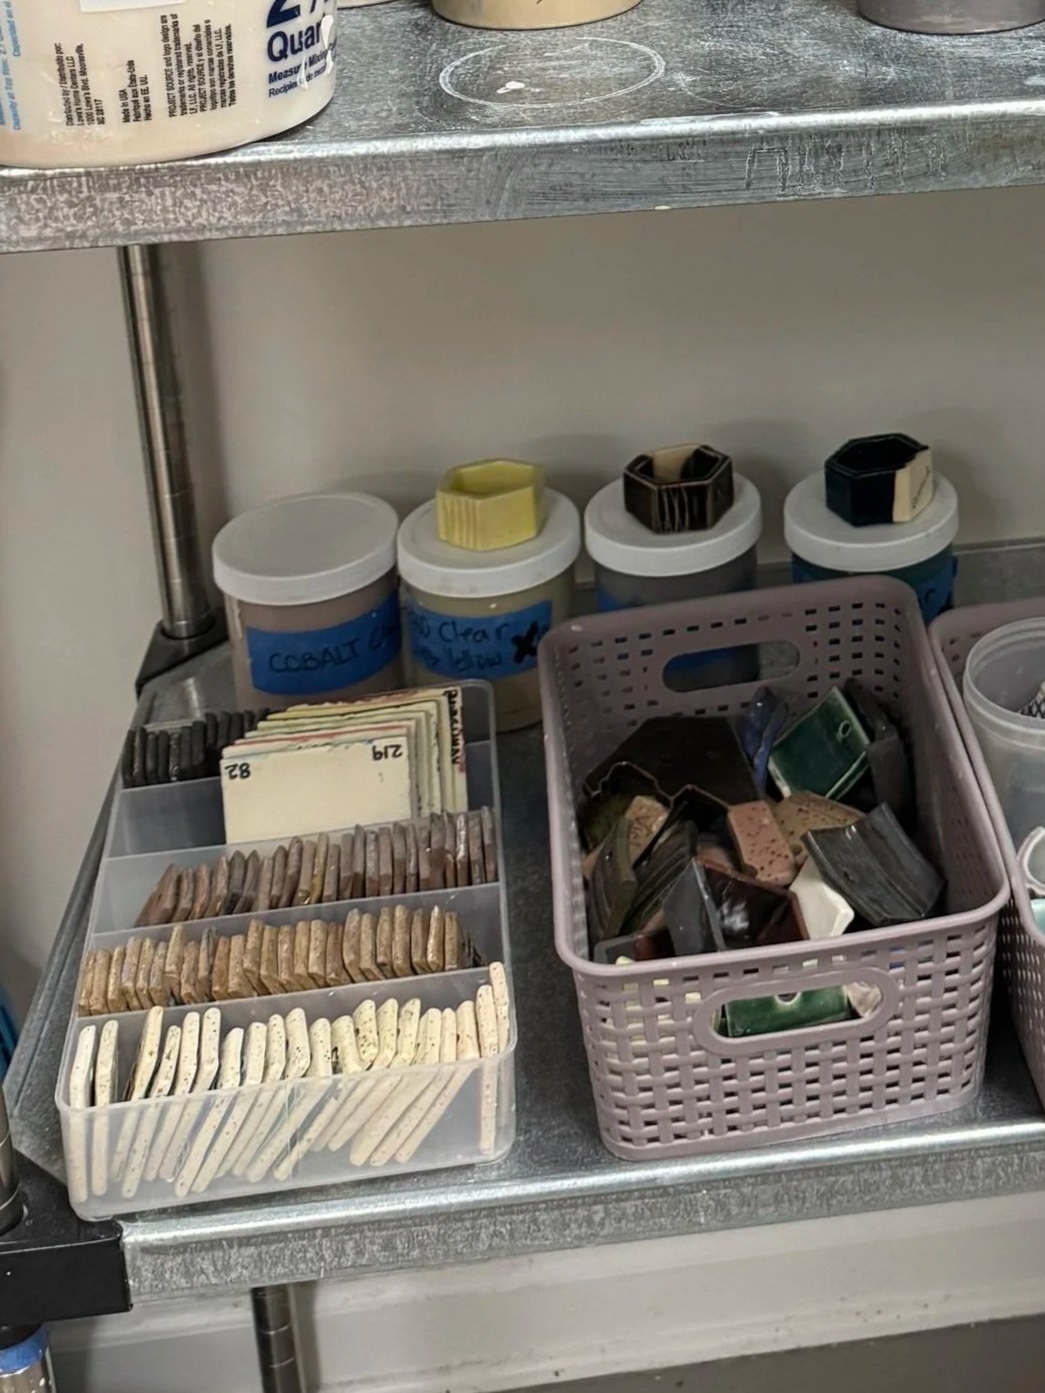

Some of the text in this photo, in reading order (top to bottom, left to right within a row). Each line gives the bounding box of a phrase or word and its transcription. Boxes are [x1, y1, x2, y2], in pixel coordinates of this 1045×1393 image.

[267, 18, 325, 63] Quar
[118, 89, 128, 101] USA
[268, 637, 361, 674] COBALT
[371, 743, 403, 761] 219
[225, 762, 251, 780] 82
